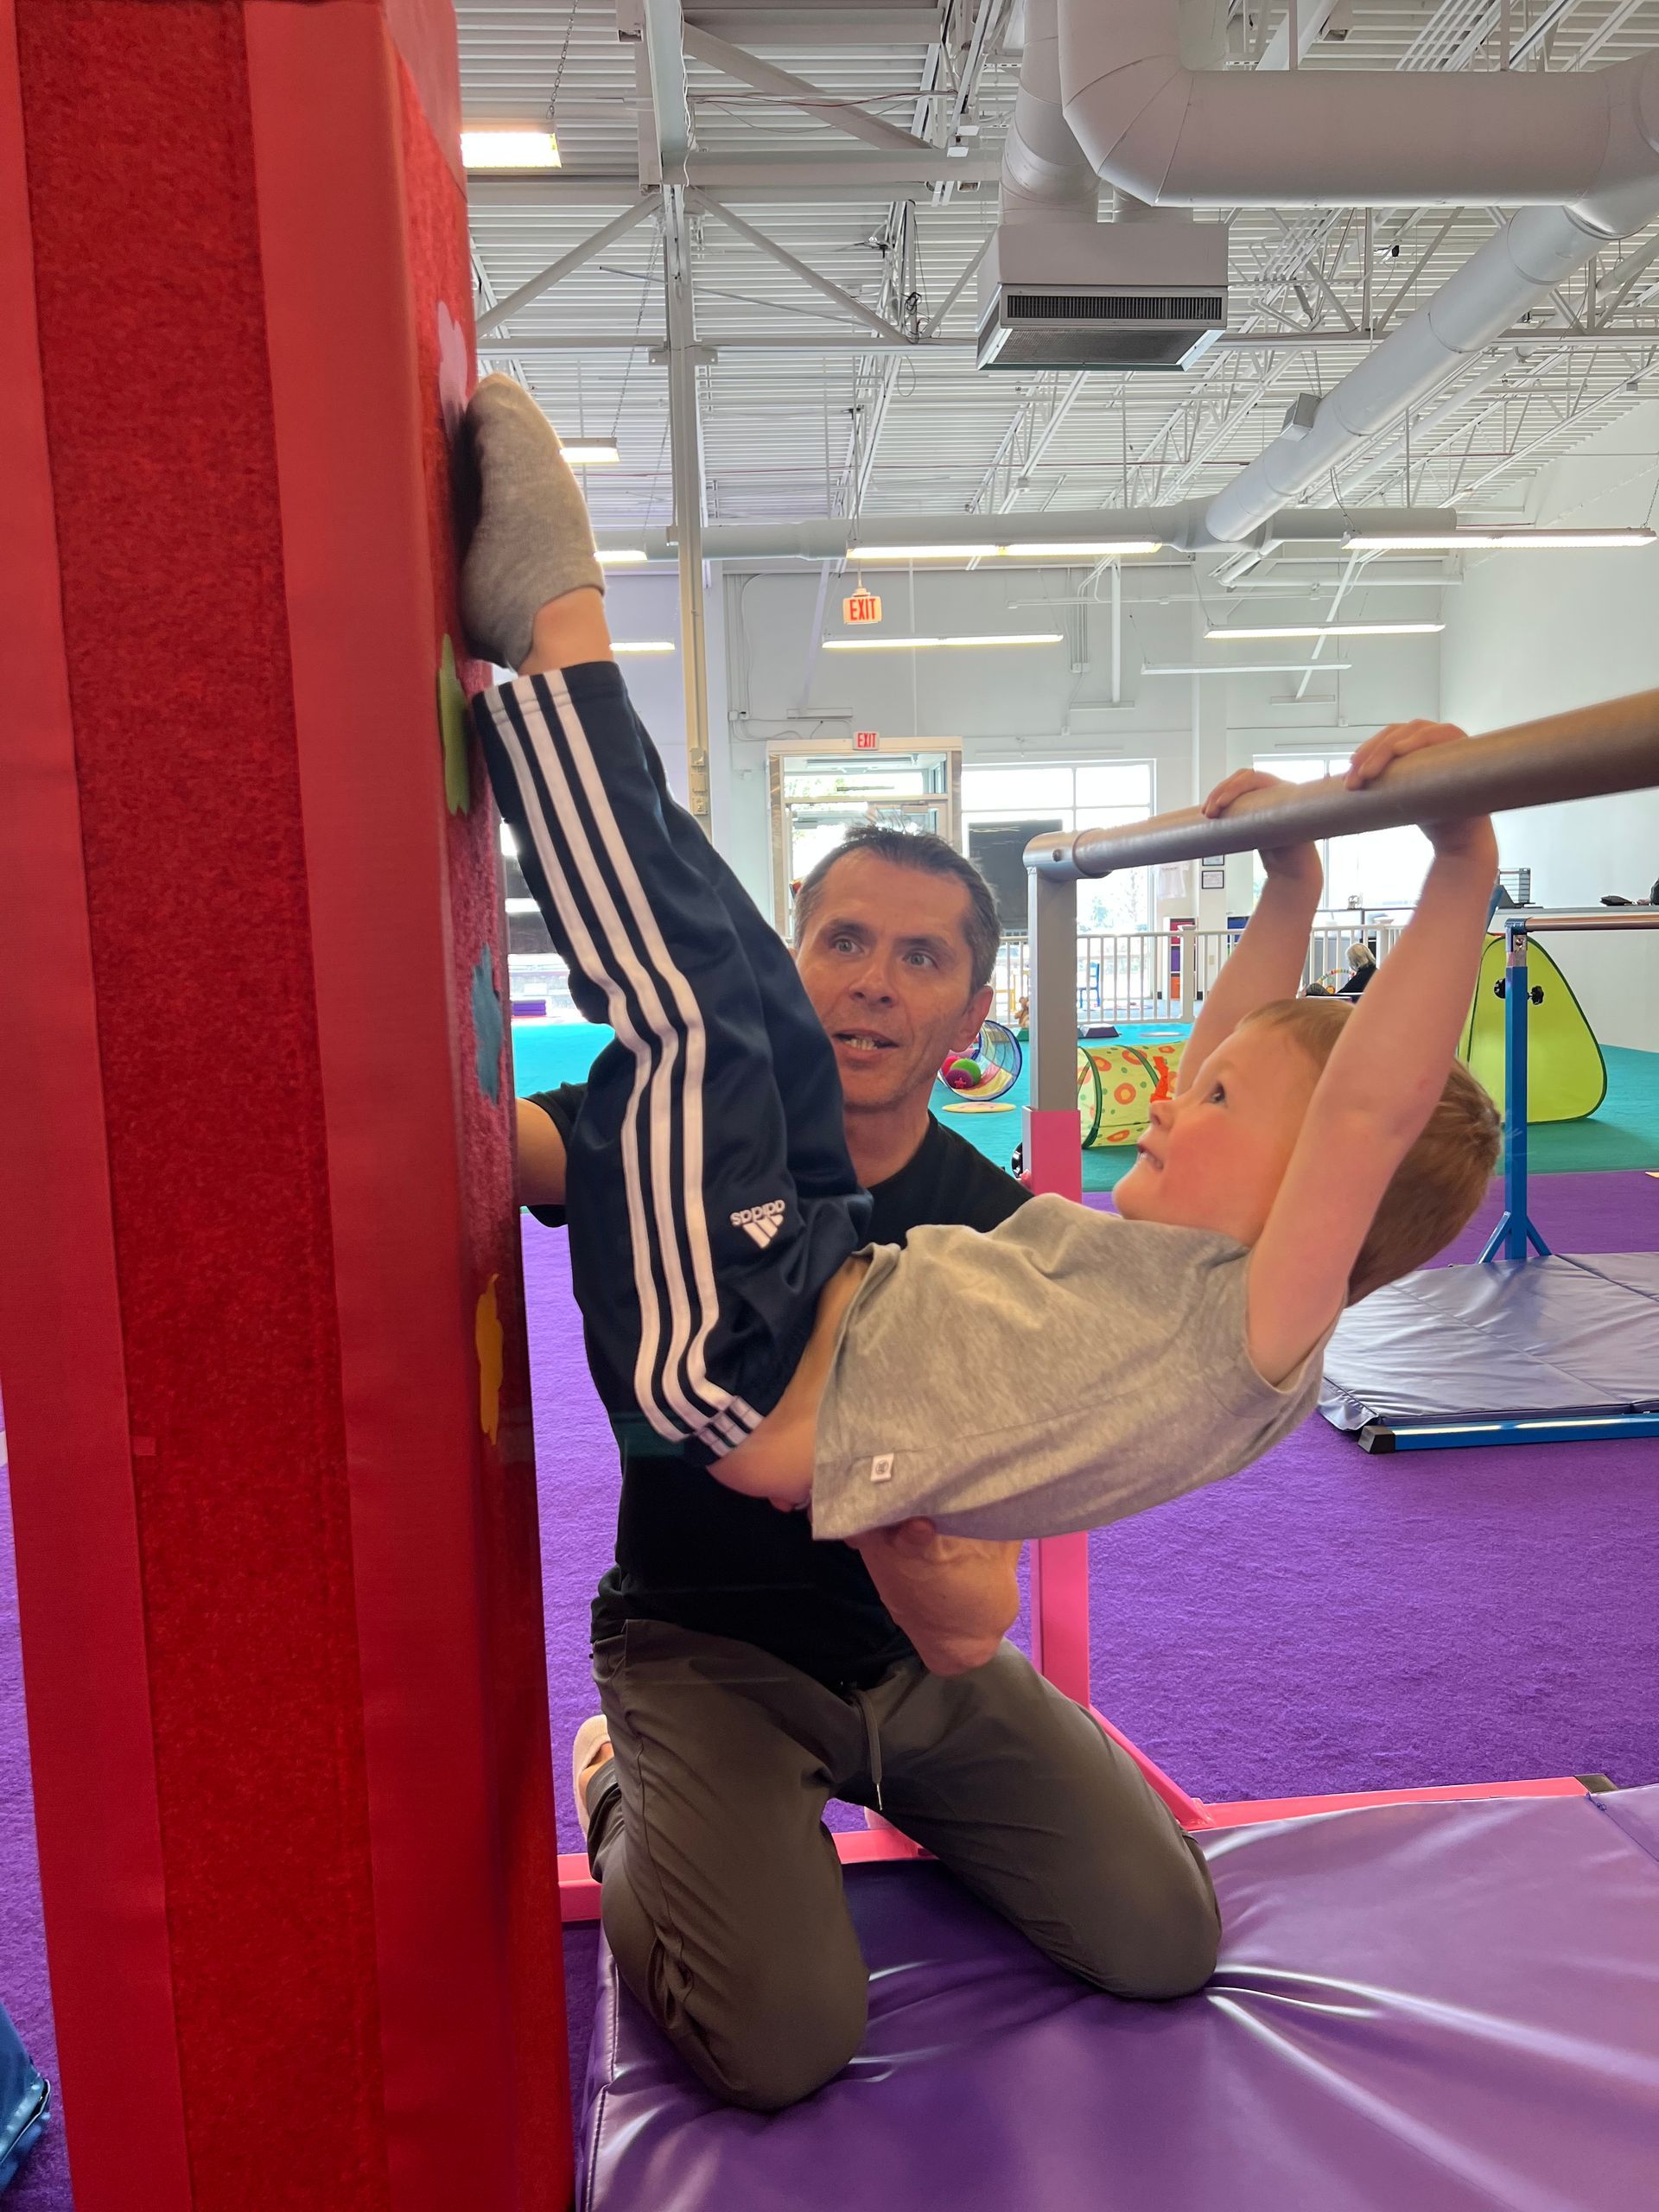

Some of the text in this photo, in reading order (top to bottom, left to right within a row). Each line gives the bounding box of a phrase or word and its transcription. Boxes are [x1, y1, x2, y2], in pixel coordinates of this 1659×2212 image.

[849, 598, 875, 620] EXIT
[857, 732, 876, 748] EXIT
[730, 1199, 785, 1226] adidas
